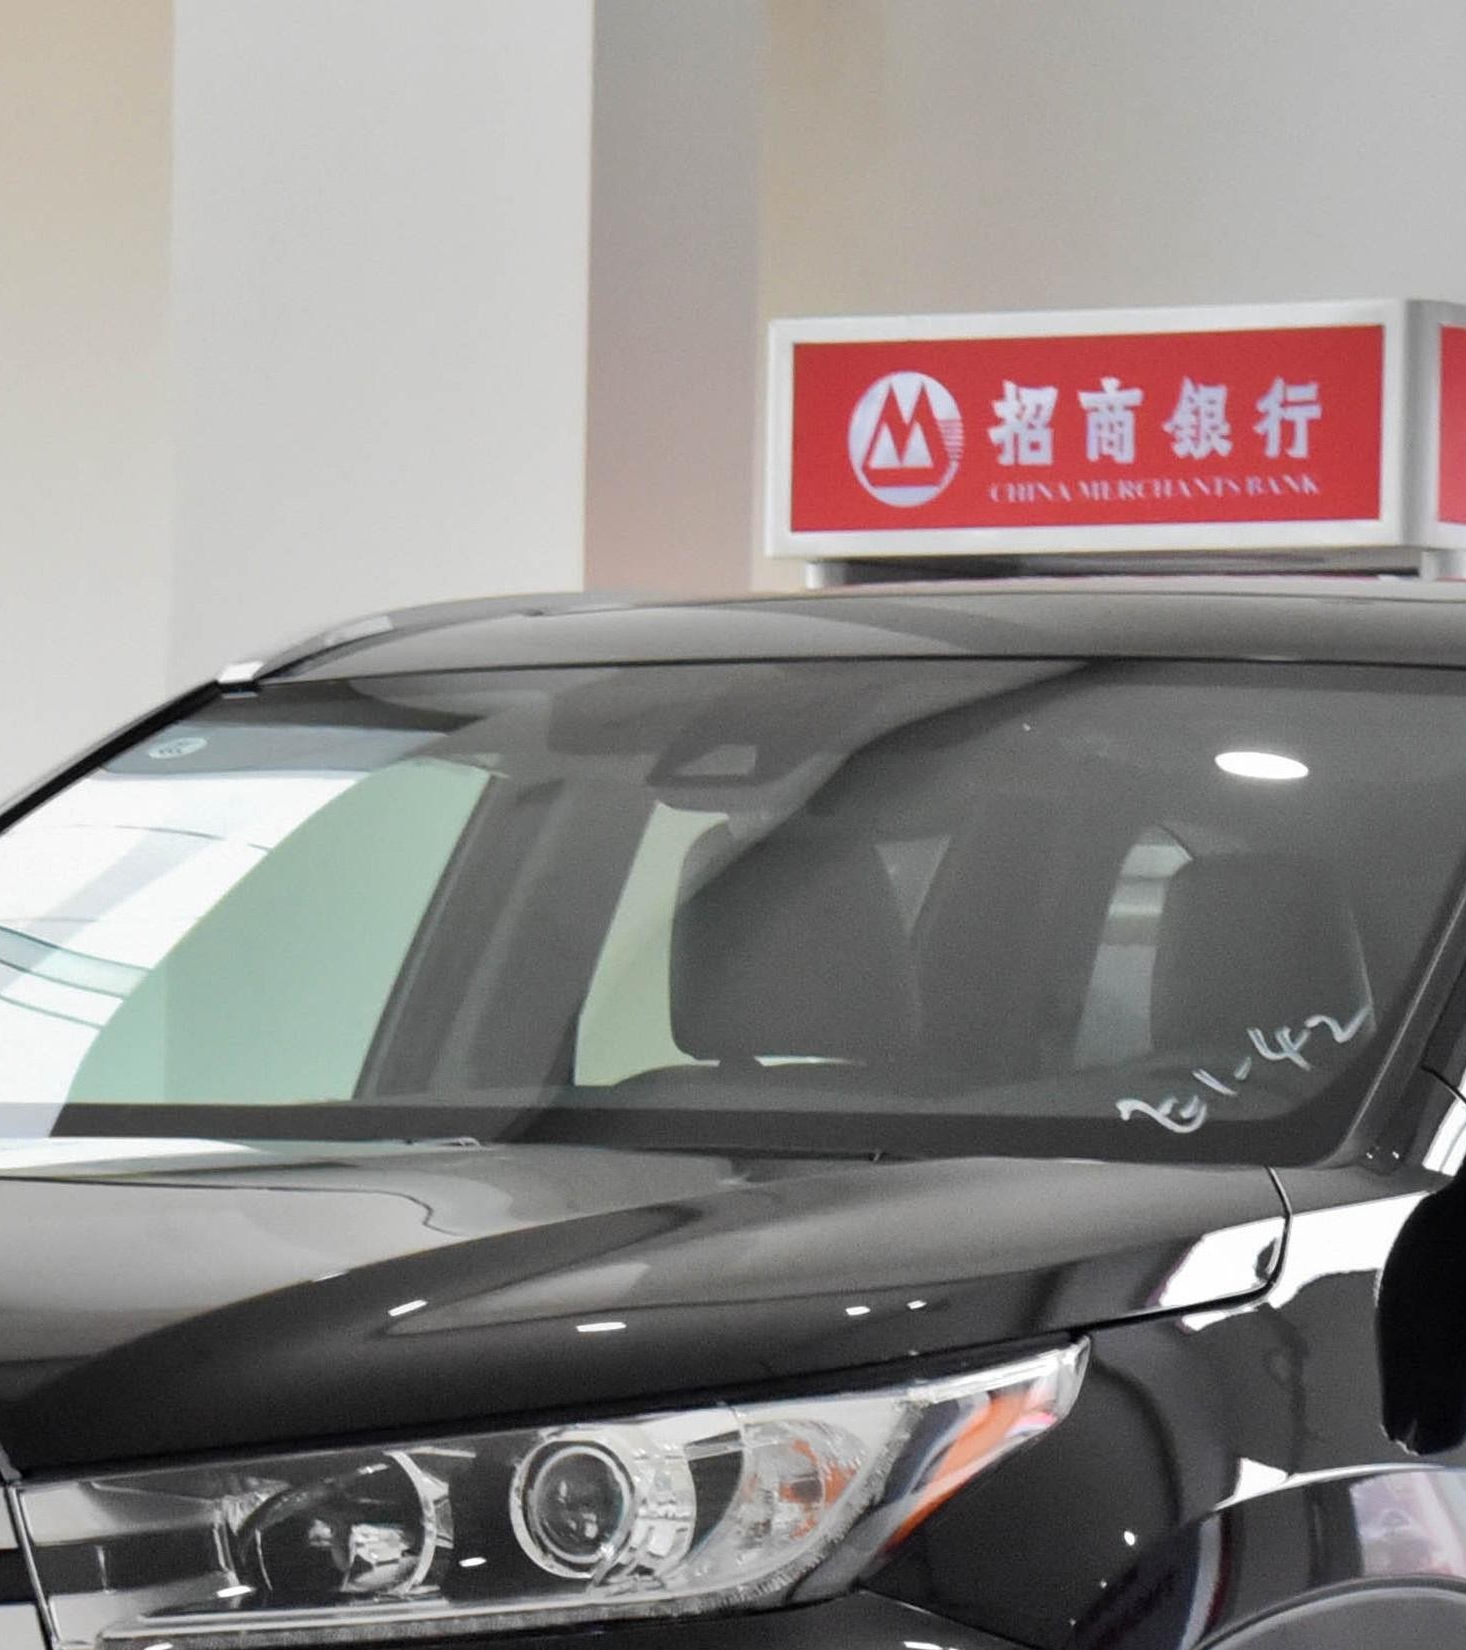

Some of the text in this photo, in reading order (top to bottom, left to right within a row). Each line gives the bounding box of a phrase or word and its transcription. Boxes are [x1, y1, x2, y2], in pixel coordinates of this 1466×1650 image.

[989, 473, 1321, 504] CHINA MERCHANTS BANK
